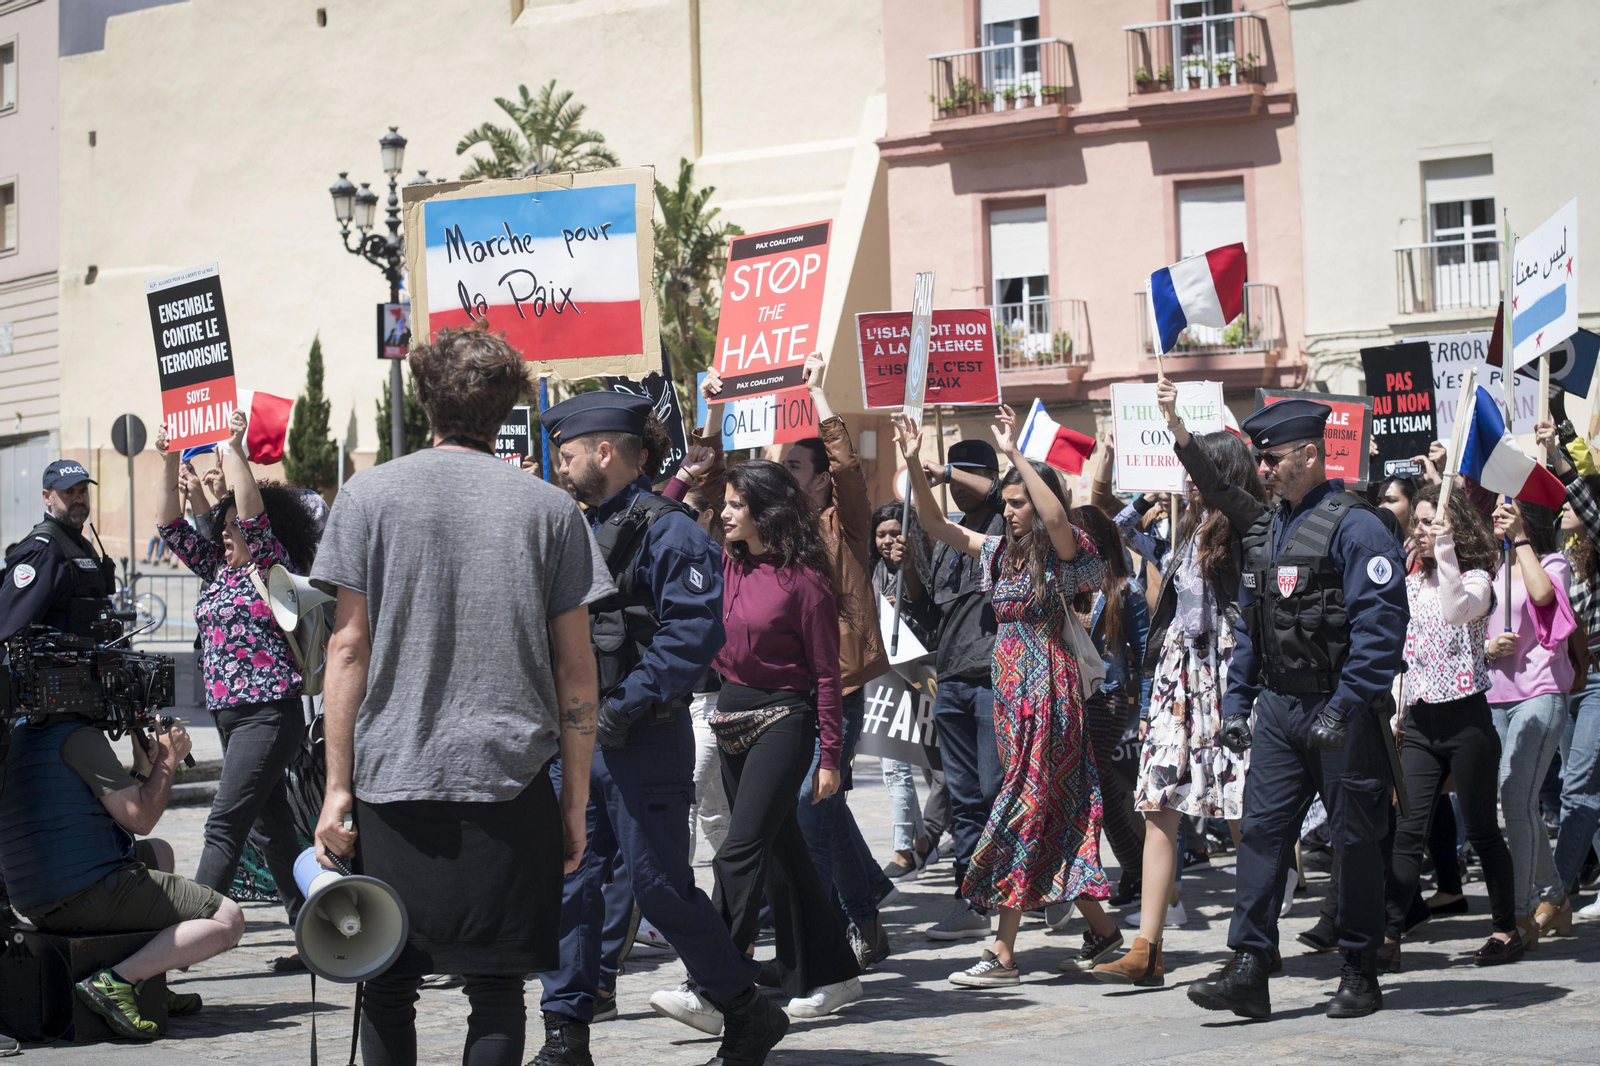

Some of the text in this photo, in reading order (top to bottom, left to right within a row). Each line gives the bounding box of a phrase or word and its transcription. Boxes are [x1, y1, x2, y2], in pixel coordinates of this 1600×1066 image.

[444, 222, 612, 263] Marche pour
[755, 235, 804, 250] PAX COALITION
[1516, 225, 1567, 286] ليس معنا
[158, 292, 215, 324] ENSEMBLE
[458, 279, 489, 323] la
[758, 303, 786, 323] THE
[162, 317, 219, 349] CONTRE LE
[866, 326, 911, 340] L'ISLA
[955, 323, 987, 336] NON
[160, 341, 229, 375] TERRORISME
[720, 324, 809, 373] HATE
[873, 341, 885, 356] À
[889, 344, 907, 354] LA
[943, 361, 983, 373] C'EST
[736, 376, 784, 390] PAX COALITION
[927, 377, 961, 389] PAIX
[1386, 371, 1413, 392] PAS
[186, 387, 210, 405] SOYEZ
[1373, 392, 1430, 416] AU NOM
[167, 400, 234, 440] HUMAIN
[497, 425, 527, 435] RISME
[1373, 415, 1432, 436] DE L'ISLAM
[495, 439, 515, 450] AS DE
[1126, 454, 1184, 467] LE TERRO
[1280, 577, 1295, 585] CRS
[863, 685, 939, 747] #AR
